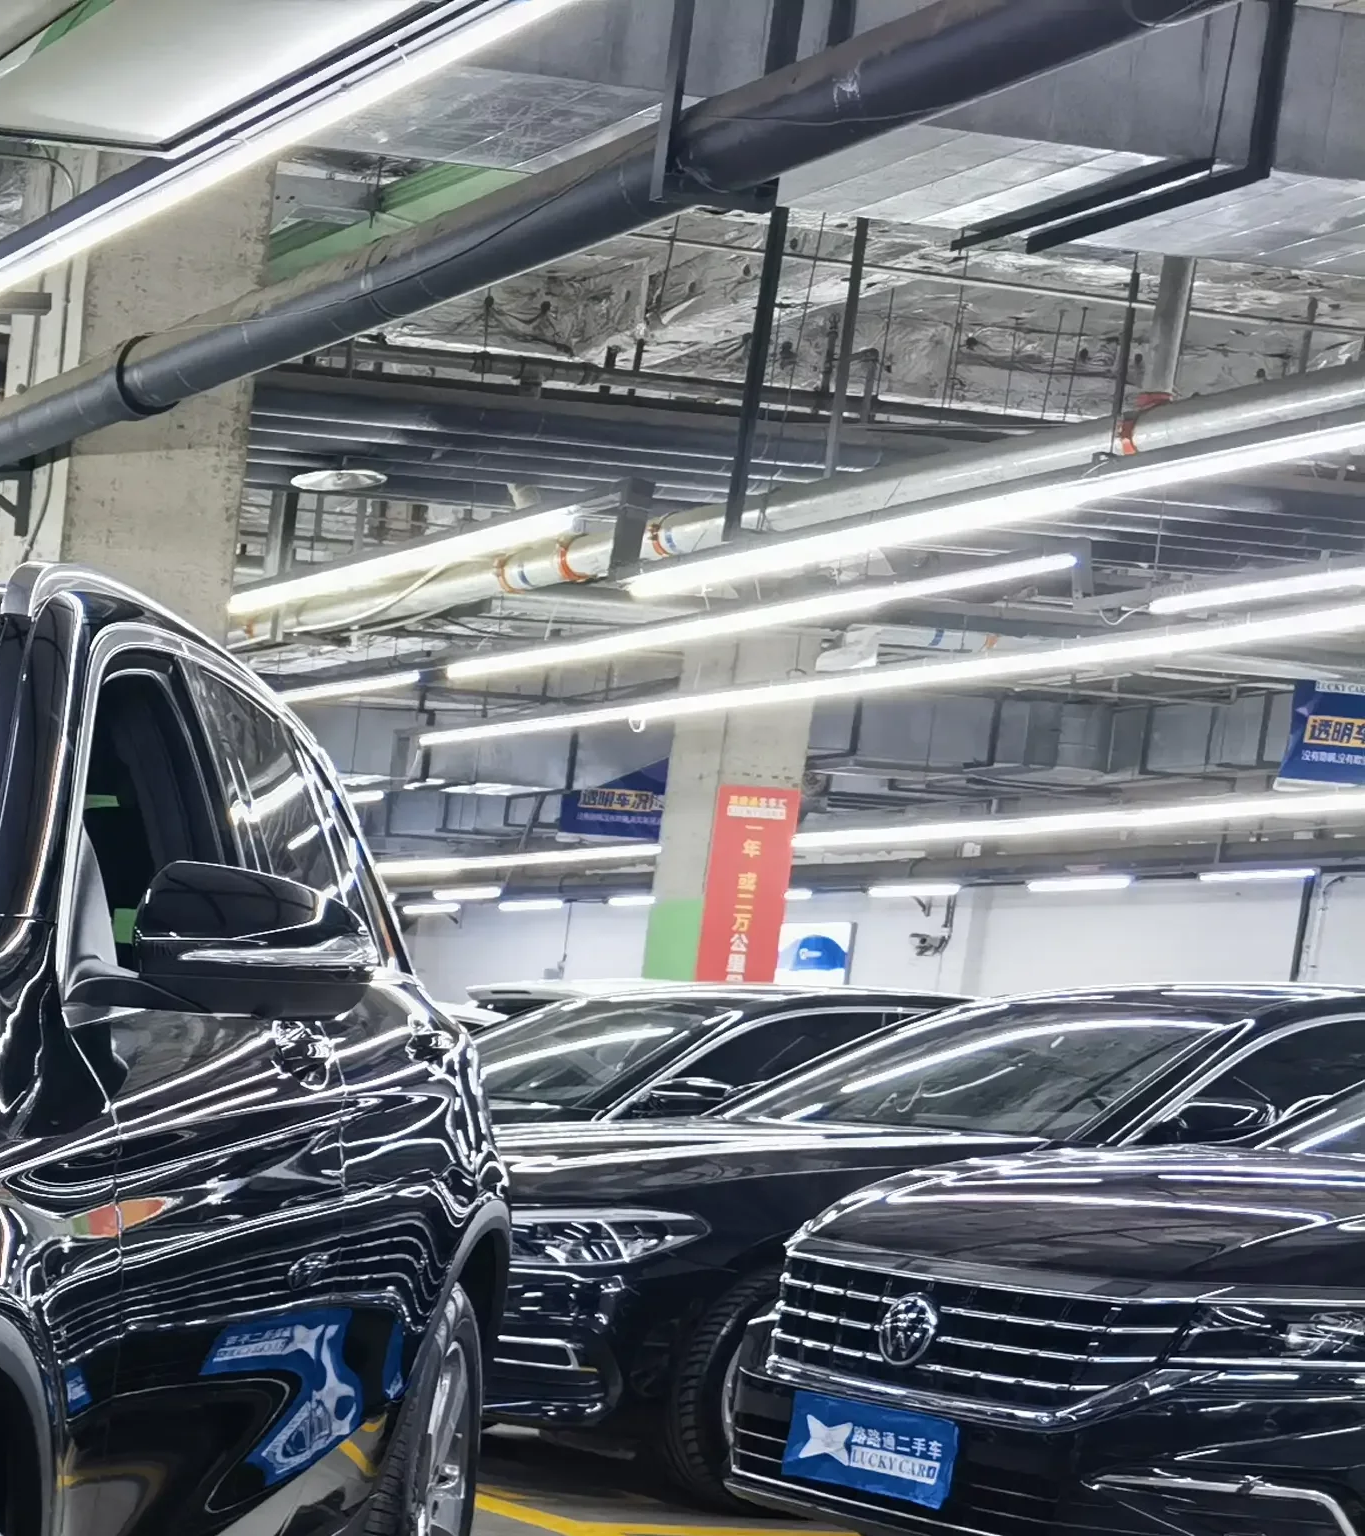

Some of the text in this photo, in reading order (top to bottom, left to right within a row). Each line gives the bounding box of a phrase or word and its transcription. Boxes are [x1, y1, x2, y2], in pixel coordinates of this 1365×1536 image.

[851, 1426, 943, 1460] 路路通二手车
[852, 1449, 929, 1477] LUCKY CAR
